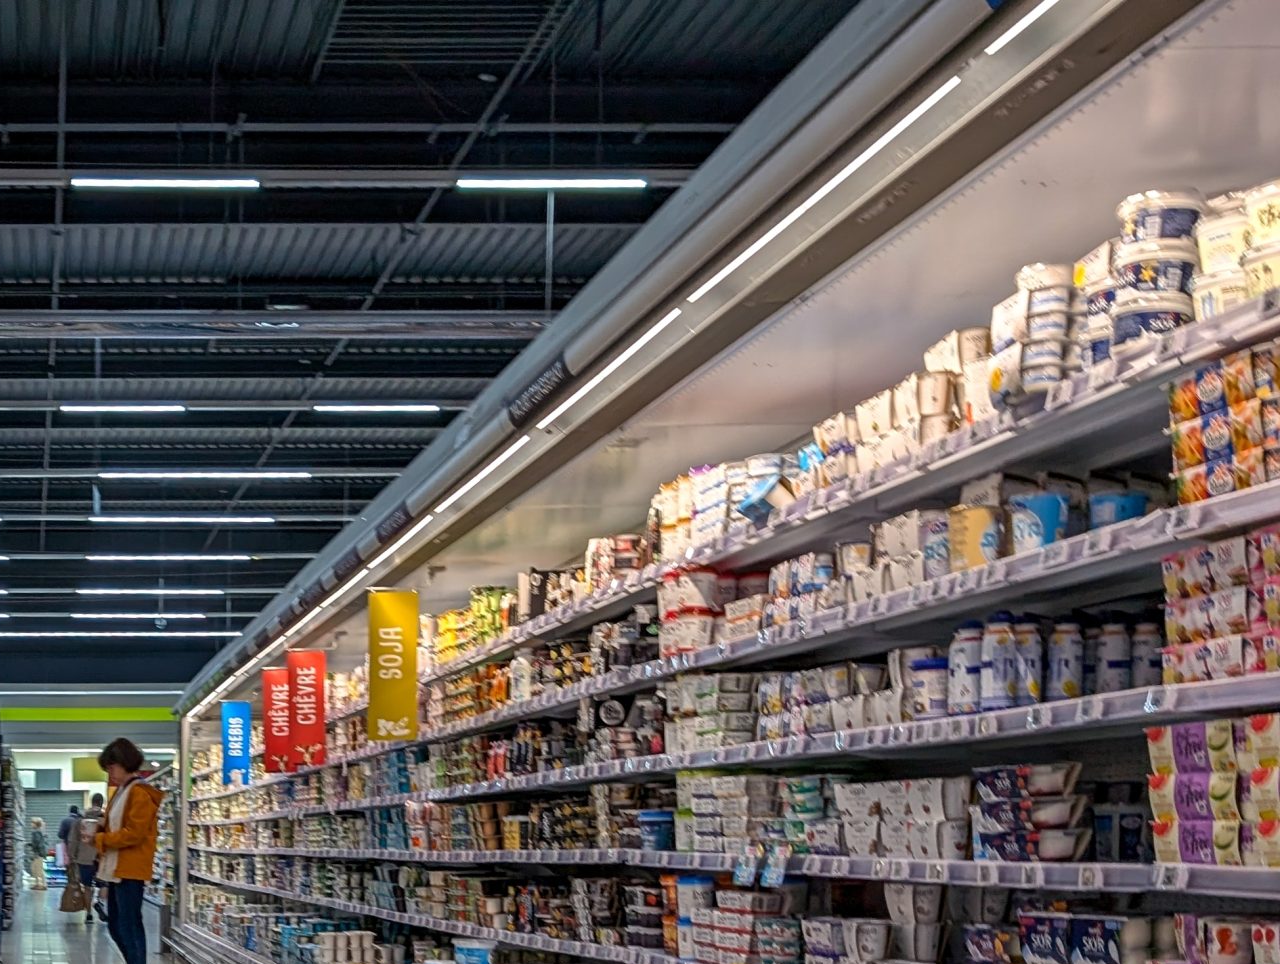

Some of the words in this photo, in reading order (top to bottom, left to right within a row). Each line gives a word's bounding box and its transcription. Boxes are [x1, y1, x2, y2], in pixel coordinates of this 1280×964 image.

[378, 626, 404, 680] SOJA
[267, 683, 290, 736] CHÈVRE
[292, 666, 317, 725] CHÈVRE
[227, 716, 244, 757] BREBIS
[1031, 932, 1053, 950] SKYR
[1082, 935, 1105, 953] SKYR
